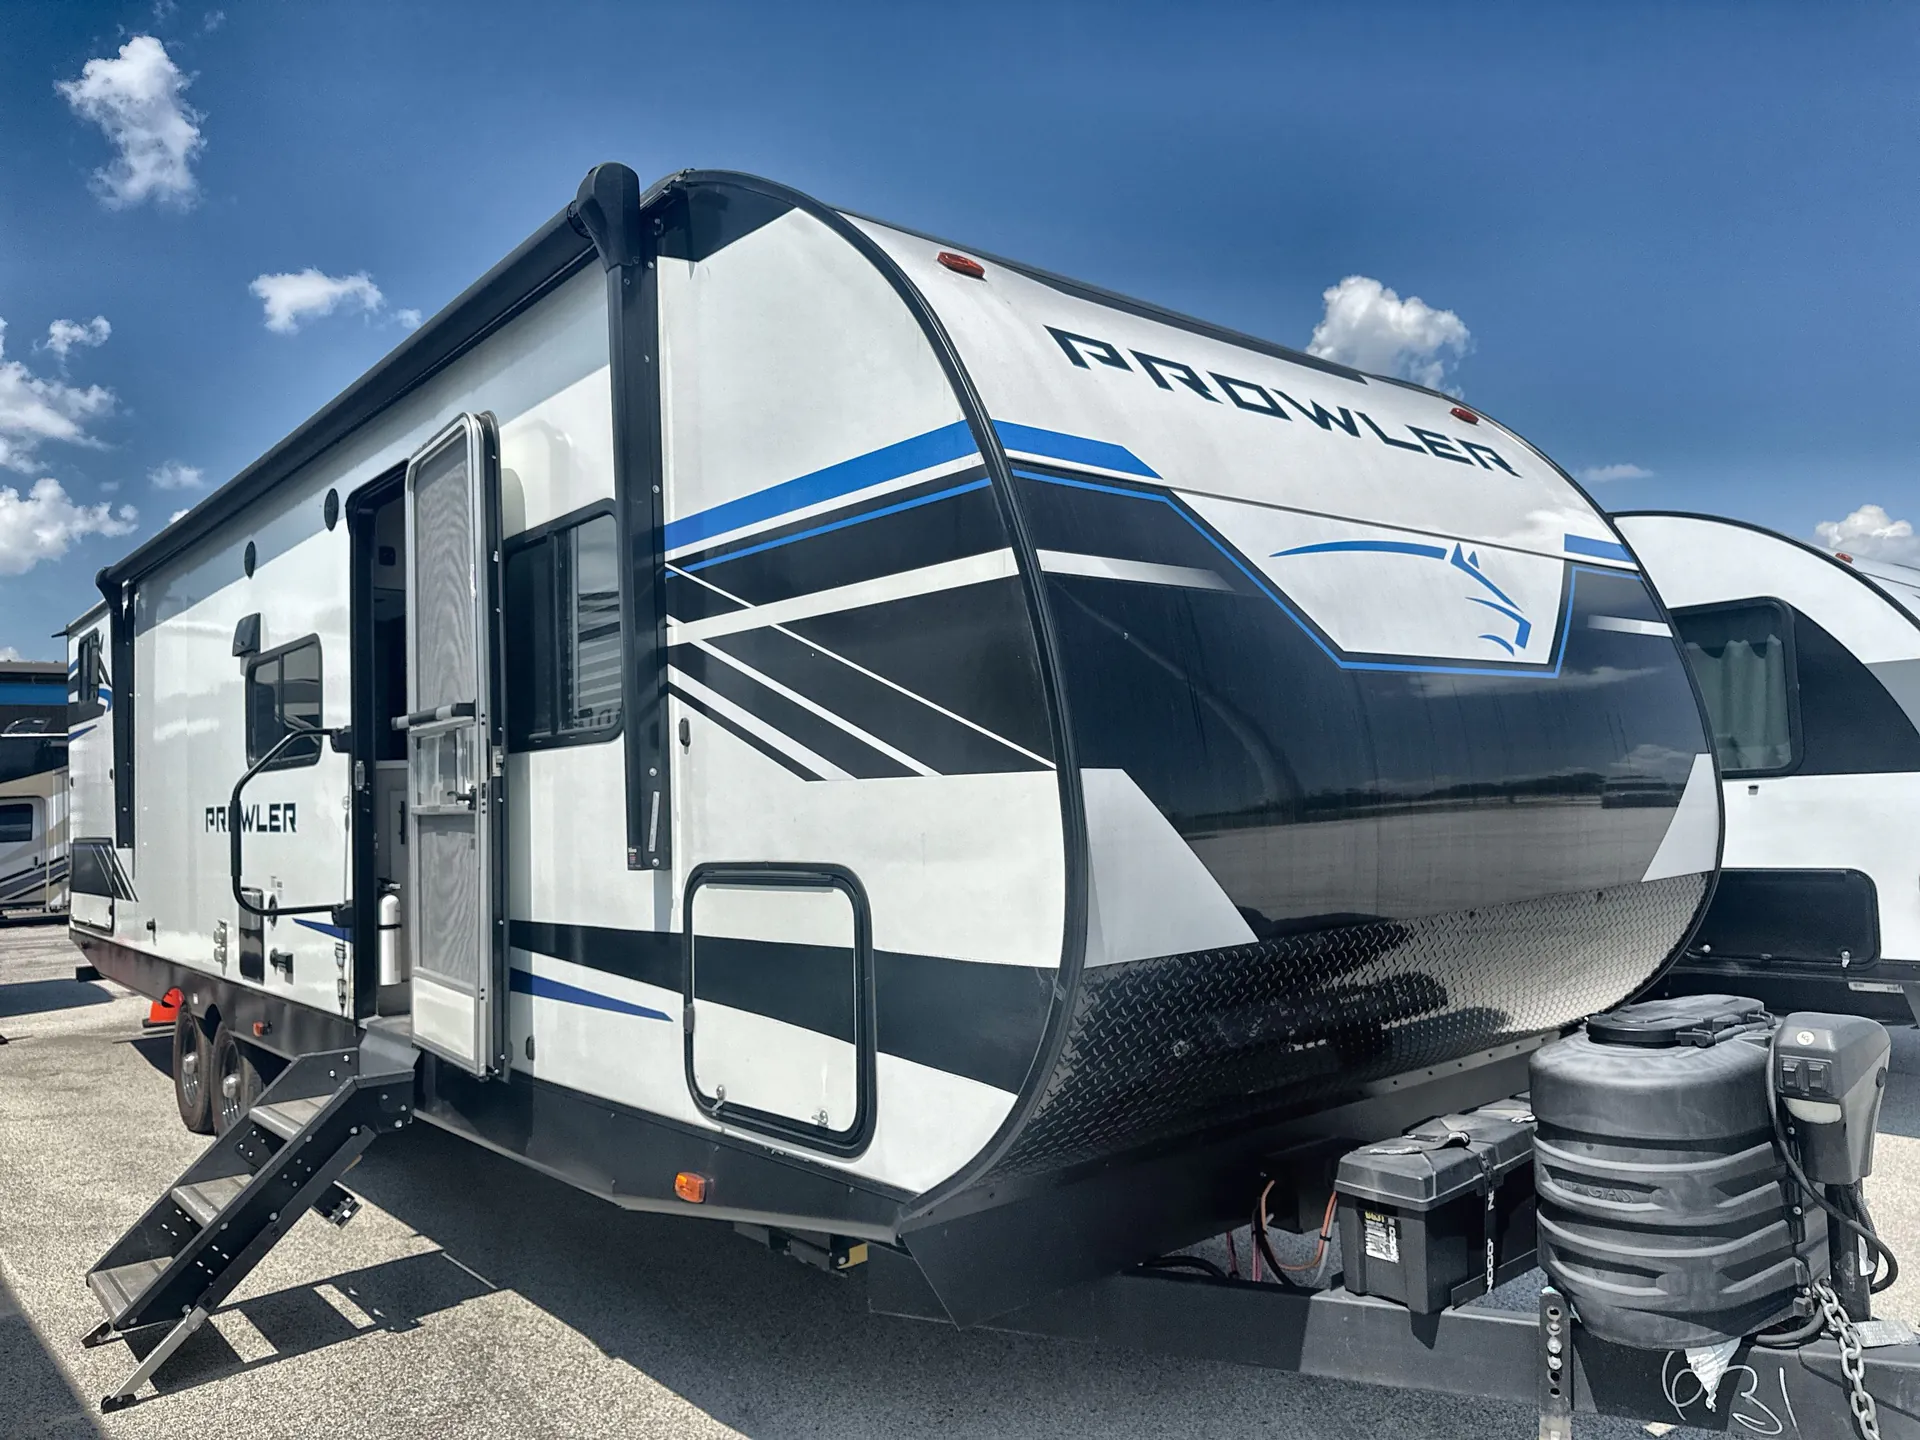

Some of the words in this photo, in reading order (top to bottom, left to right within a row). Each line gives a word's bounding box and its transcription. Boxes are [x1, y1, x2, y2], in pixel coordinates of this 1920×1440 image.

[1043, 324, 1522, 478] PROWLER
[205, 802, 297, 833] PRWLER
[1486, 1240, 1494, 1293] NOCO
[1661, 1350, 1803, 1440] 631
